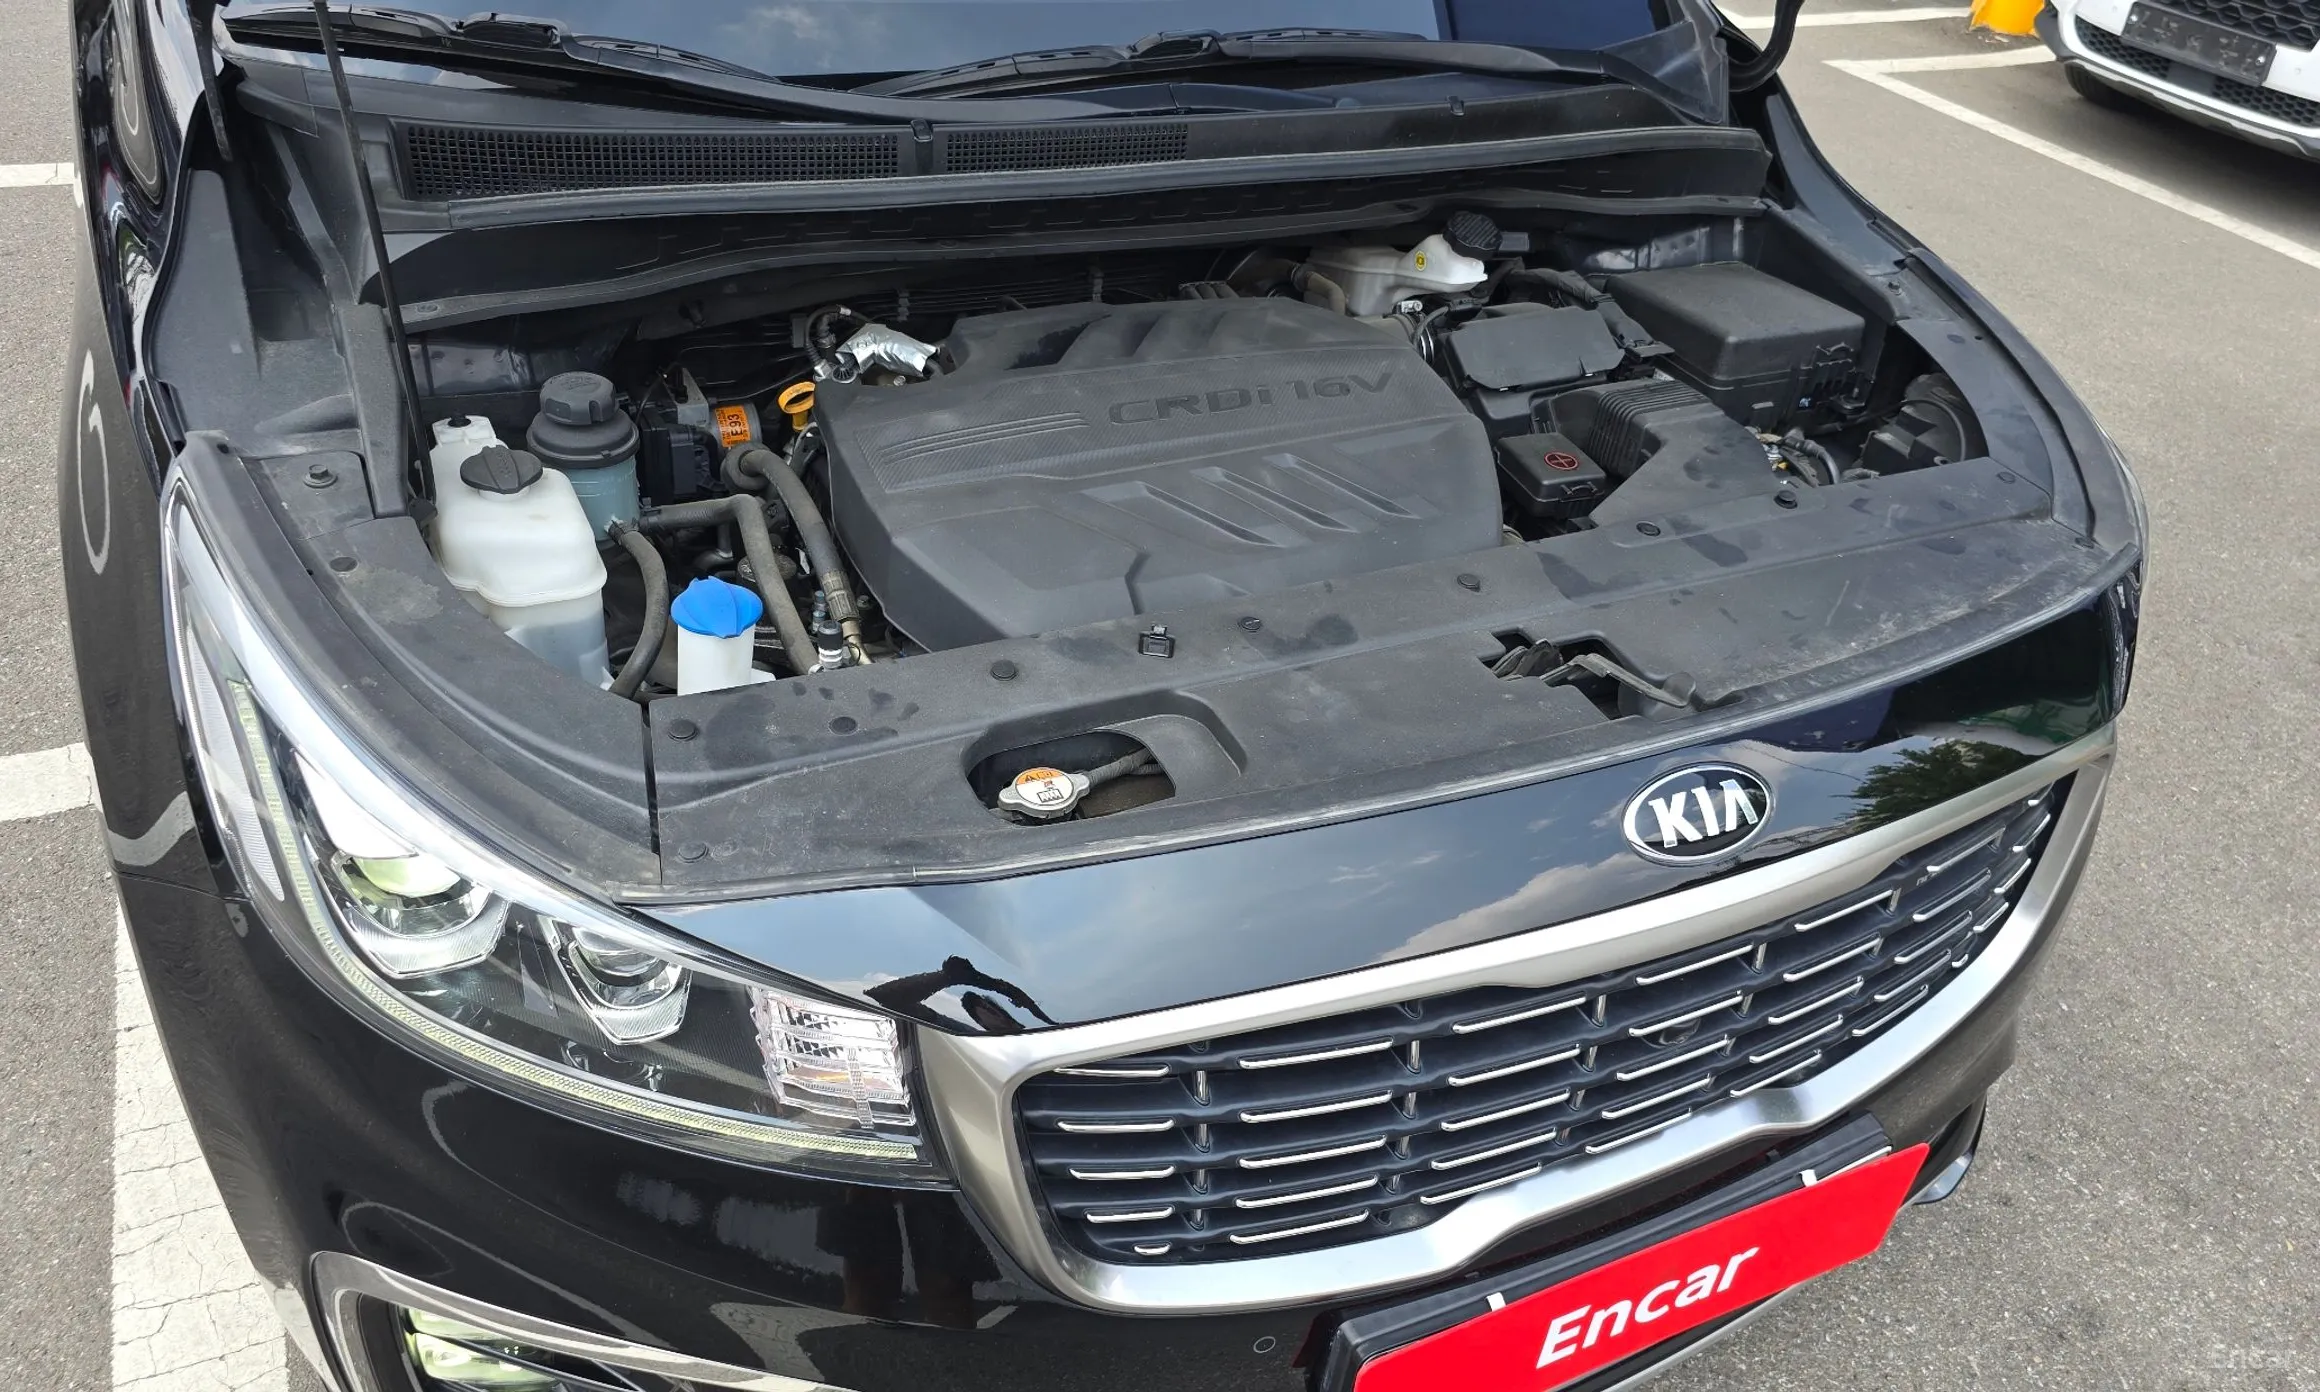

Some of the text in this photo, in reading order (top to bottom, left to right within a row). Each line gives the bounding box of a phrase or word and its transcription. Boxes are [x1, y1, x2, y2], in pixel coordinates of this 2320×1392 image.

[1286, 372, 1392, 400] 16V
[726, 413, 744, 437] E93
[1648, 778, 1759, 848] KIA
[1536, 1246, 1760, 1369] Encar
